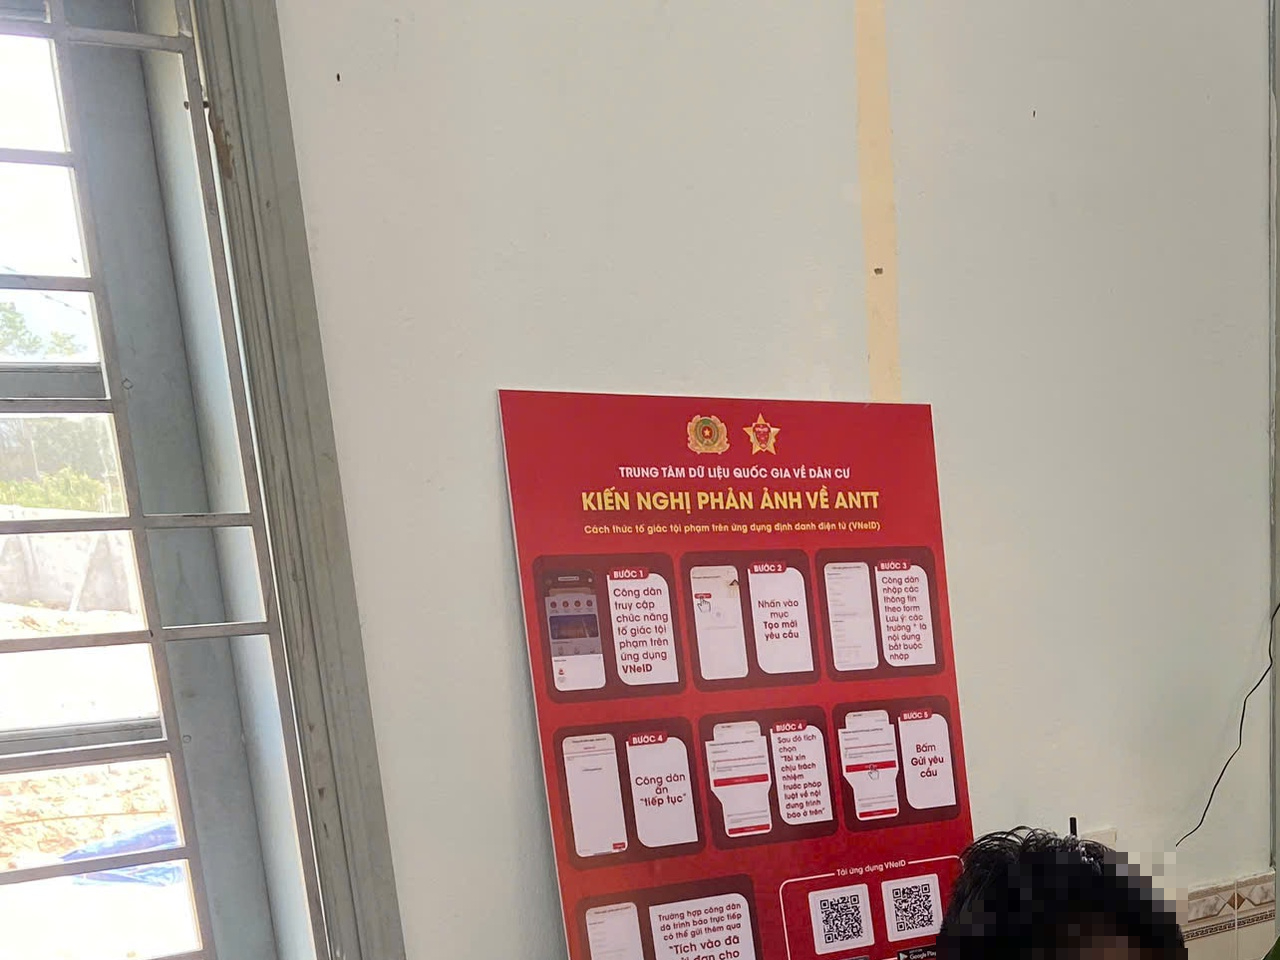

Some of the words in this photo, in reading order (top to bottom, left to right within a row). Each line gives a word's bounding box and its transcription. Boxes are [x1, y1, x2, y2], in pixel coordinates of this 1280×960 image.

[619, 467, 659, 478] TRUNG
[661, 465, 685, 478] TÂM
[689, 465, 705, 478] DỮ
[708, 466, 729, 480] LIỆU
[733, 465, 767, 478] QUỐC
[771, 468, 791, 478] GIA
[794, 465, 806, 478] VỀ
[810, 467, 831, 478] DÂN
[835, 467, 850, 478] CƯ
[581, 486, 630, 511] KIẾN
[637, 492, 691, 514] NGHỊ
[697, 487, 753, 509] PHẢN
[761, 487, 802, 509] ẢNH
[806, 485, 829, 509] VỀ
[835, 492, 879, 508] ANTT
[584, 525, 609, 534] Cách
[612, 524, 632, 533] thức
[635, 524, 645, 533] tố
[647, 524, 667, 534] giác
[670, 524, 681, 533] tội
[684, 525, 709, 534] phạm
[712, 523, 728, 531] trên
[732, 523, 748, 533] ứng
[750, 522, 772, 533] dụng
[775, 522, 792, 531] định
[795, 522, 816, 530] danh
[818, 521, 835, 531] điện
[838, 521, 846, 530] tử
[849, 521, 880, 531] (VNeID)
[754, 564, 775, 572] BƯỚC
[614, 569, 637, 578] BƯỚC
[882, 577, 902, 585] Công
[614, 588, 640, 598] Công
[643, 588, 662, 596] dân
[758, 599, 781, 608] Nhấn
[884, 596, 905, 604] thông
[615, 602, 632, 611] truy
[636, 601, 654, 610] cập
[644, 613, 668, 622] năng
[764, 621, 779, 629] Tạo
[782, 620, 797, 628] mới
[618, 625, 627, 635] tố
[631, 627, 651, 637] giác
[655, 625, 666, 634] tội
[765, 632, 780, 641] yêu
[783, 630, 799, 638] cầu
[901, 633, 920, 641] dung
[620, 639, 647, 650] phạm
[650, 638, 668, 646] trên
[621, 652, 639, 662] ứng
[642, 651, 667, 660] dụng
[622, 664, 652, 674] VNeID
[776, 723, 796, 731] BƯỚC
[633, 735, 656, 744] BƯỚC
[916, 743, 936, 753] Bấm
[911, 756, 926, 766] Gửi
[928, 756, 944, 766] yêu
[921, 768, 937, 777] cầu
[636, 776, 663, 786] Công
[666, 773, 685, 782] dân
[837, 868, 847, 876] Tải
[849, 866, 863, 875] ứng
[865, 864, 883, 872] dụng
[884, 860, 906, 869] VNeID
[658, 912, 685, 921] Trường
[687, 909, 702, 917] hợp
[704, 906, 724, 914] công
[726, 903, 741, 911] dân
[673, 921, 690, 929] trình
[693, 918, 708, 926] báo
[710, 916, 725, 924] trực
[727, 912, 742, 921] tiếp
[705, 925, 724, 933] thêm
[727, 922, 741, 930] qua
[700, 939, 721, 949] vào
[725, 935, 739, 945] đã
[719, 950, 740, 960] cho
